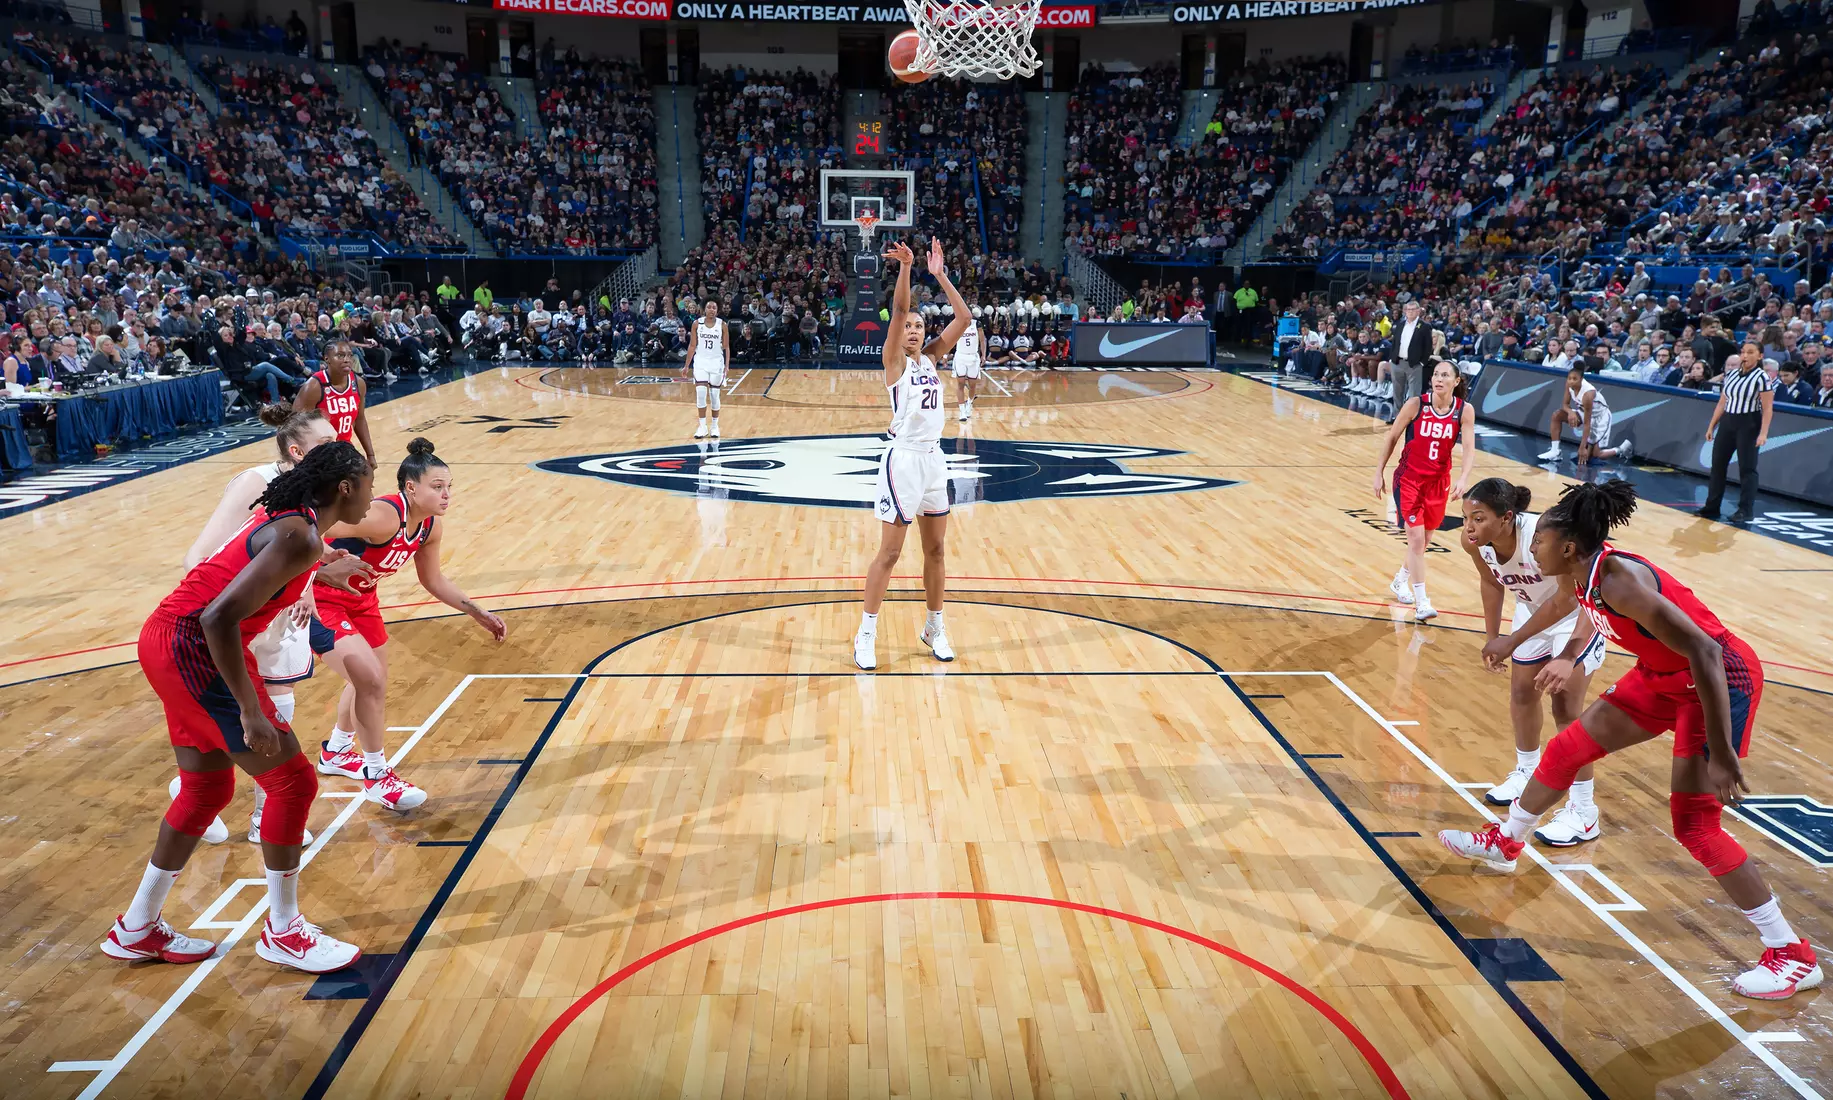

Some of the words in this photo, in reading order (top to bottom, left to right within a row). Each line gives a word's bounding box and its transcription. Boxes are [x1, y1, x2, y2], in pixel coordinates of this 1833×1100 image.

[677, 3, 727, 19] ONLY
[730, 4, 745, 19] A
[749, 5, 859, 21] HEARTBEAT
[862, 7, 913, 22] AWA
[1173, 5, 1224, 22] ONLY
[1225, 4, 1241, 19] A
[1245, 0, 1357, 18] HEARTBEAT
[858, 121, 882, 134] 4:12
[855, 133, 879, 155] 24
[704, 340, 714, 350] 13
[839, 344, 882, 355] TRAVELE
[966, 338, 971, 347] 5
[326, 395, 358, 415] USA
[921, 388, 938, 410] 20
[338, 415, 353, 434] 18
[1420, 420, 1453, 439] USA
[1428, 440, 1440, 461] 6
[1492, 569, 1543, 585] ONN
